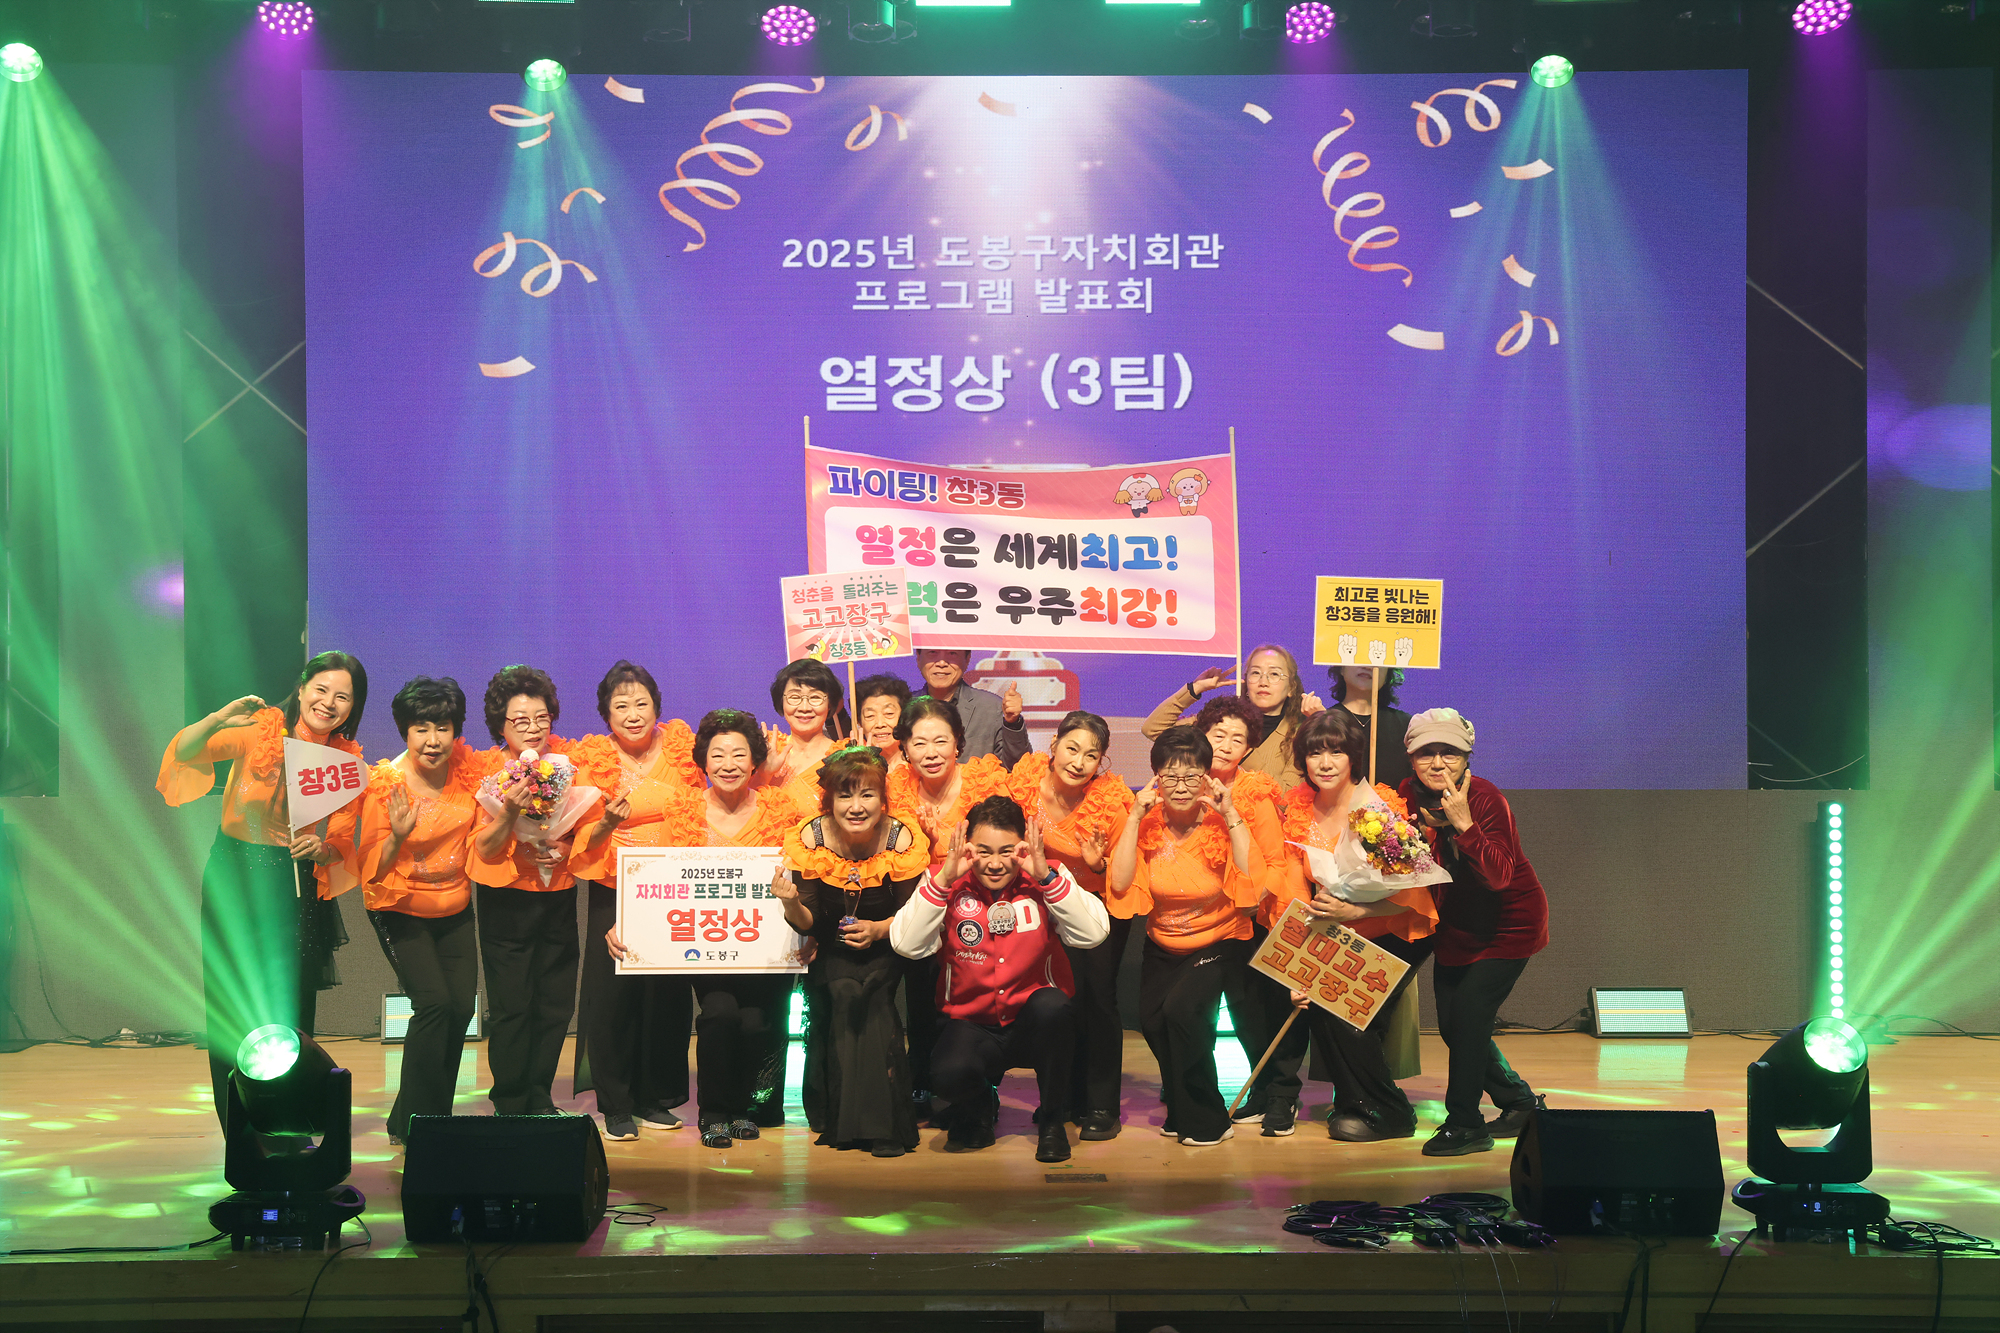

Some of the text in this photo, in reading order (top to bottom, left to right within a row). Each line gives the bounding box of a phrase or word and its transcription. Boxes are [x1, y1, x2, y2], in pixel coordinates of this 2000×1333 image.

[782, 233, 1225, 271] 2025년 도봉구자치회관
[852, 277, 1153, 314] 프로그램 발표회
[819, 352, 1193, 413] 열정상 (3팀)
[827, 464, 1026, 509] 파이팅! 창3동
[855, 524, 1179, 571] 열정은 세계최고!
[791, 581, 898, 604] 청춘을 돌려주는
[906, 580, 1179, 629] 력은 우주최강!
[1334, 586, 1429, 605] 최고로 빛나는
[802, 601, 892, 629] 고고장구
[1325, 605, 1437, 625] 창3동을 응원해!
[829, 641, 867, 658] 창3동
[297, 761, 361, 796] 창3동
[636, 883, 777, 899] 자치회관 프로그램 발표
[681, 868, 744, 880] 2025년 도봉구
[666, 908, 763, 942] 열정상
[1012, 897, 1041, 933] D
[706, 950, 739, 961] 도봉구
[1280, 915, 1389, 994] 절대고수
[1326, 924, 1366, 954] 창3동
[1261, 941, 1375, 1017] 고고장구
